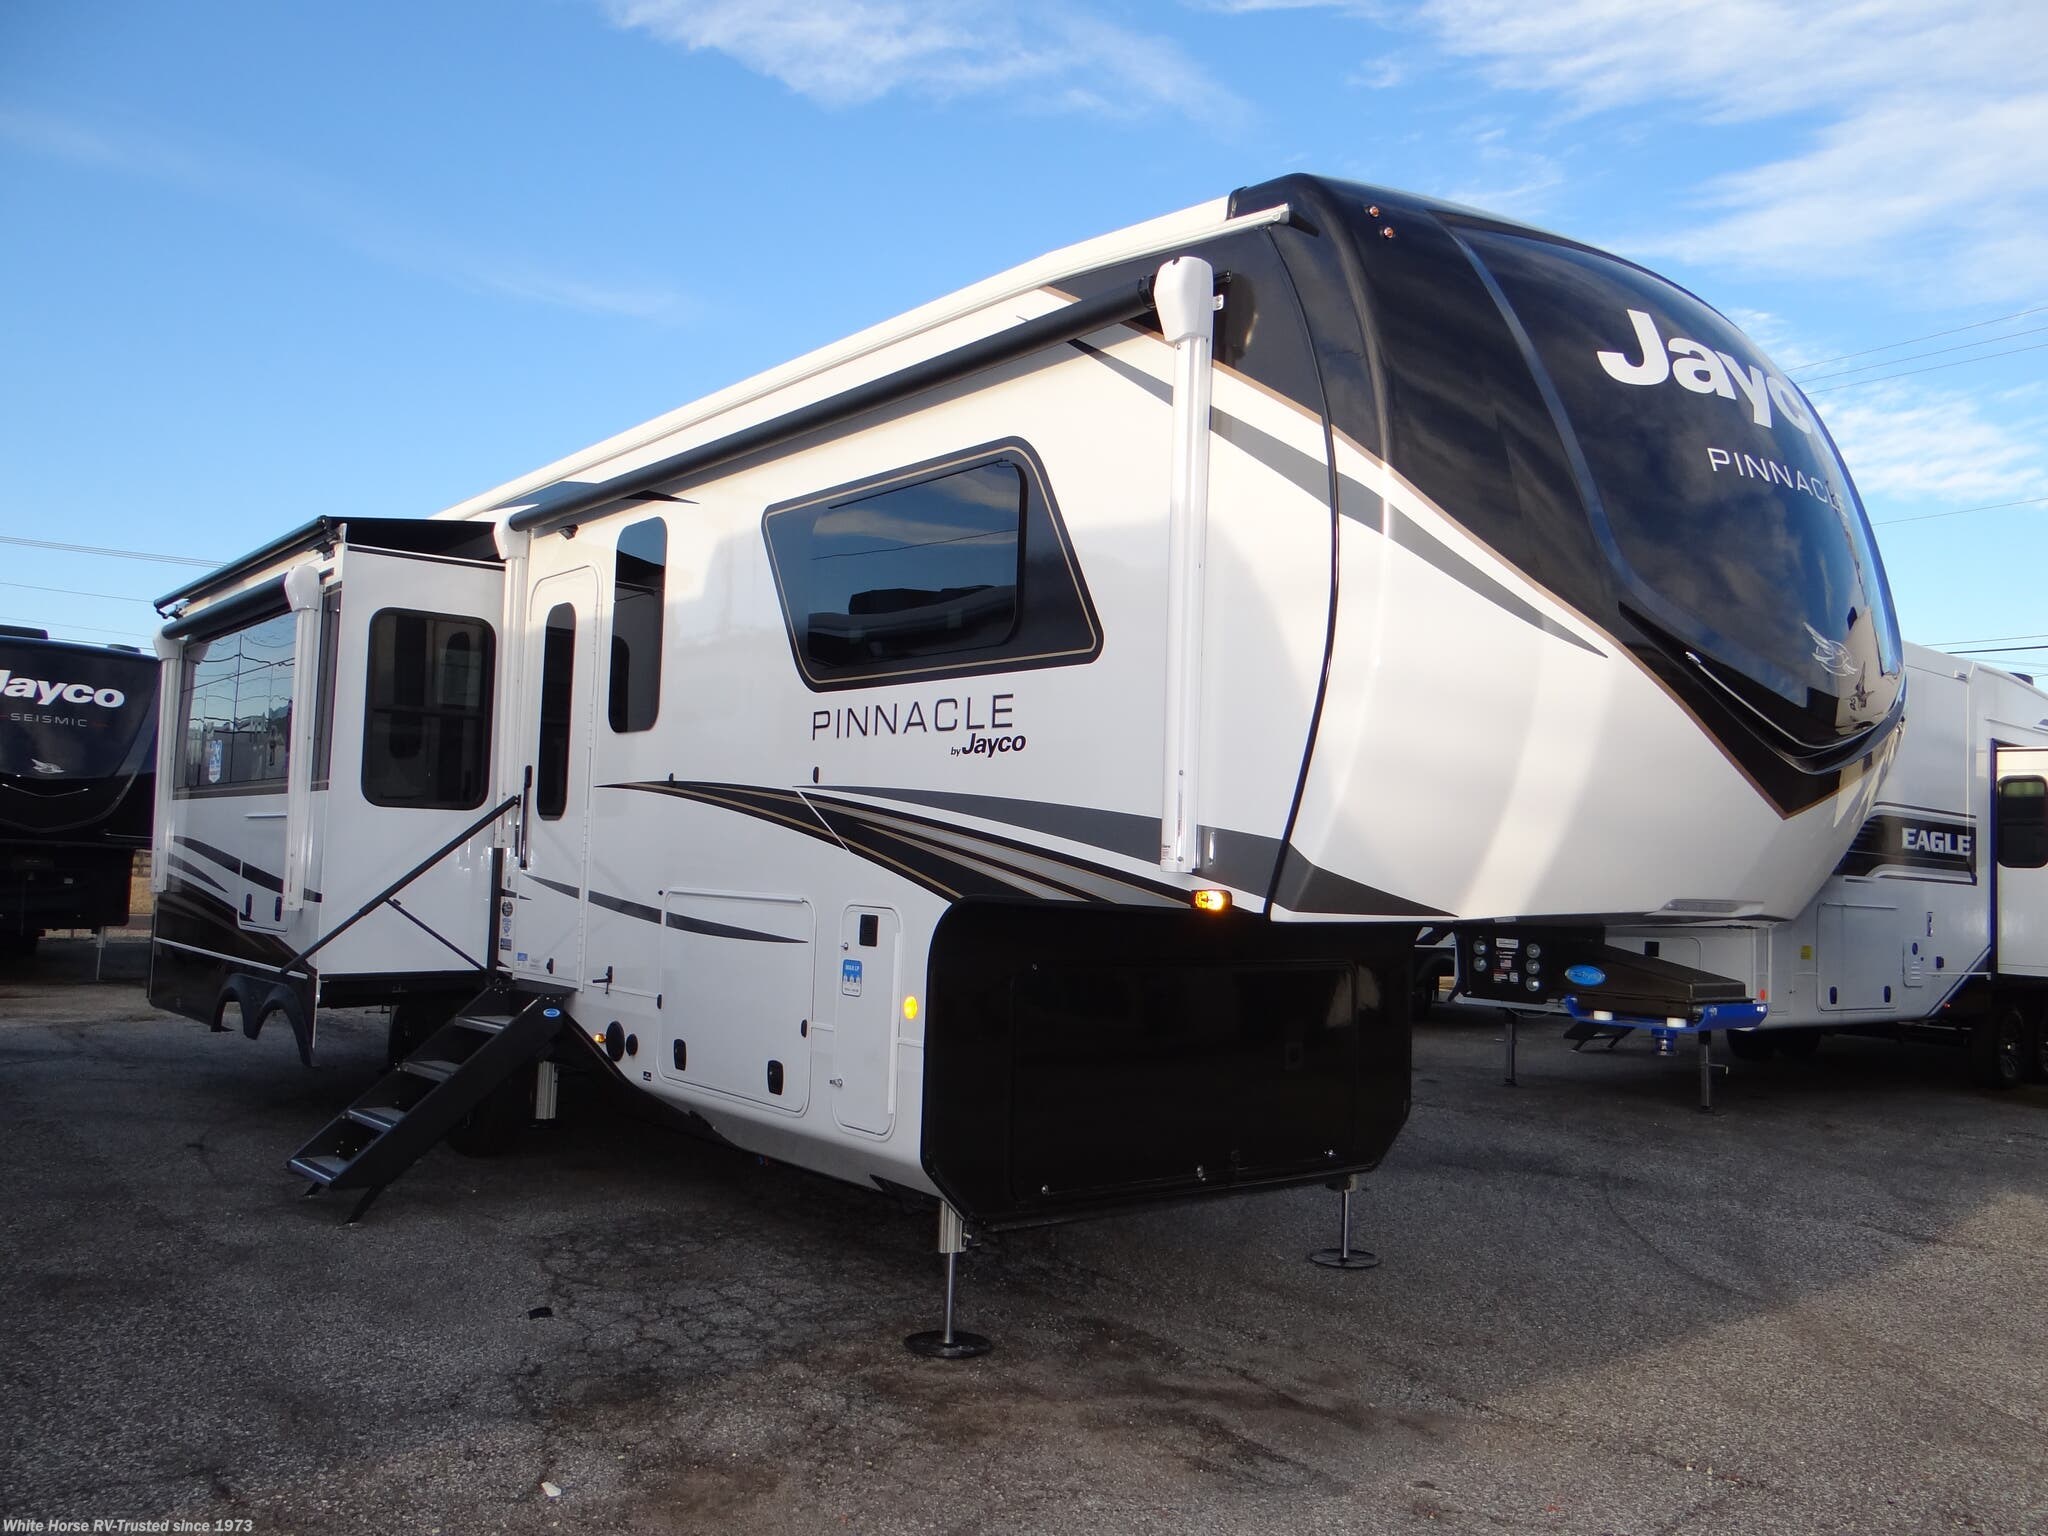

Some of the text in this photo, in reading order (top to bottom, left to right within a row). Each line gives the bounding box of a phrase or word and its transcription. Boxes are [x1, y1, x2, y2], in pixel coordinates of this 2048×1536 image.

[1597, 309, 1813, 435] Jayc
[1707, 447, 1849, 518] PINNACLE
[10, 712, 88, 728] SEISMIC
[812, 693, 1015, 741] PINNACLE
[950, 732, 1026, 758] by Jayco
[1901, 827, 1972, 856] EAGLE
